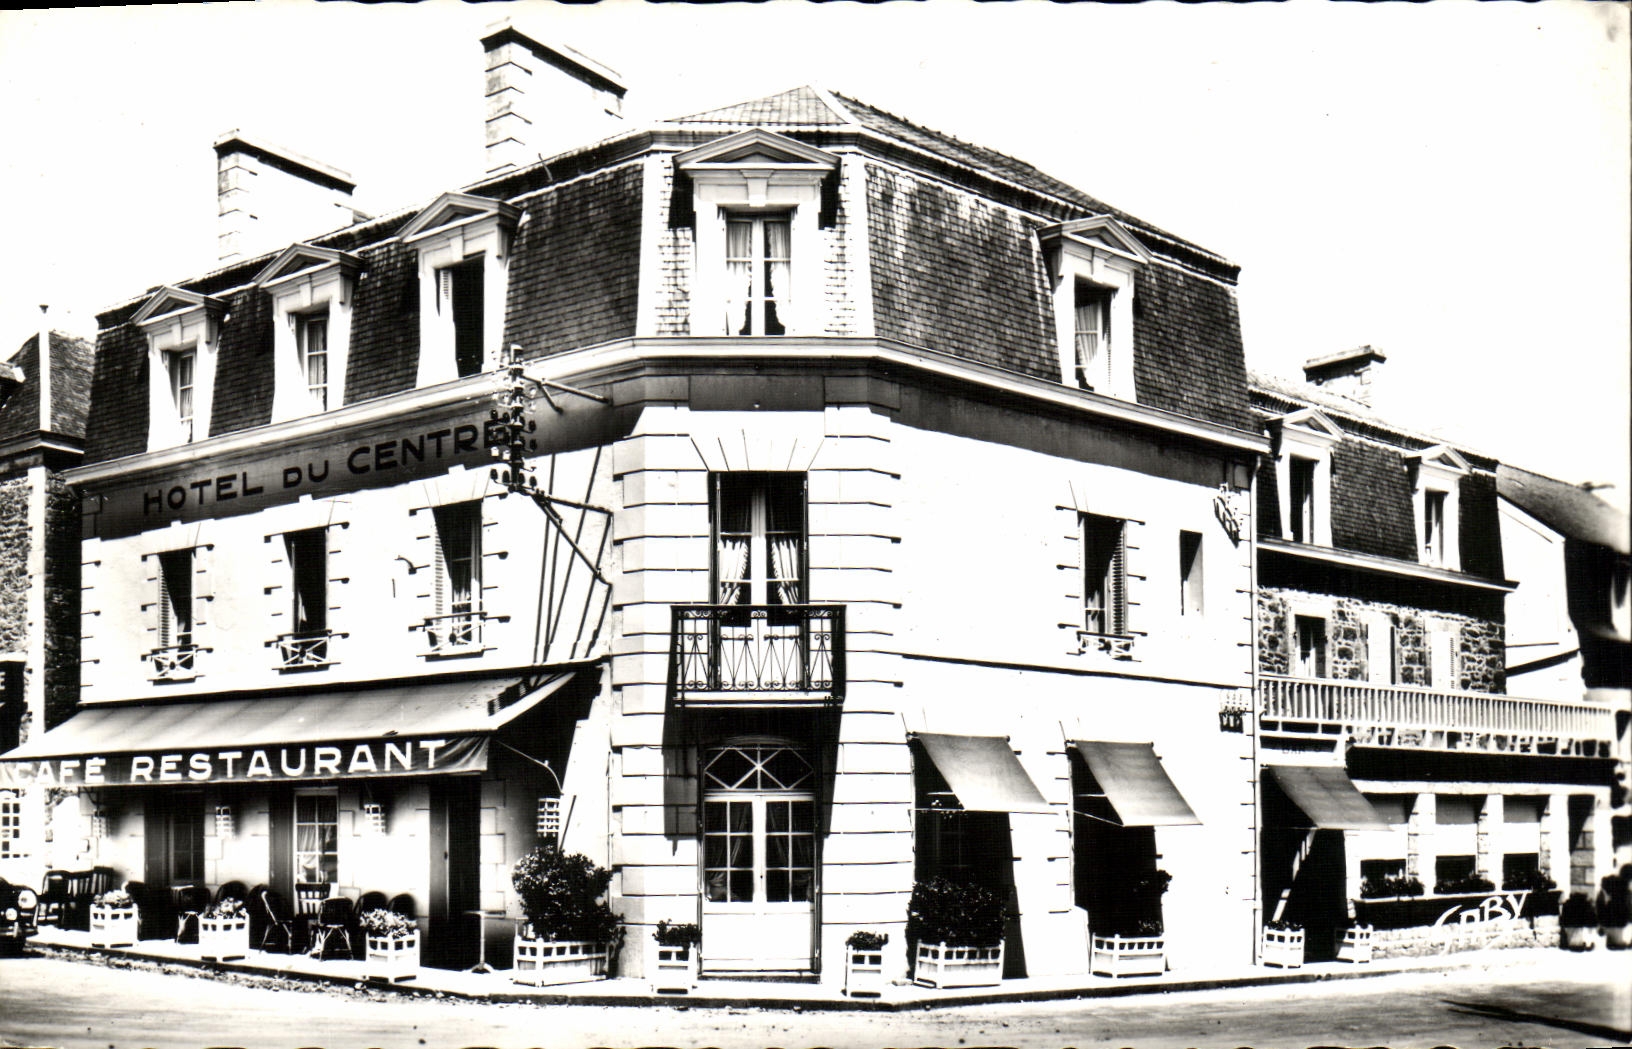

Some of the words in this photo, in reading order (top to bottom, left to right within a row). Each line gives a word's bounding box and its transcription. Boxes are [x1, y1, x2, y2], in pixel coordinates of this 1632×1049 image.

[143, 472, 263, 516] HOTEL
[283, 460, 329, 489] DU
[347, 417, 509, 475] CENTRE
[15, 757, 106, 786] CAFÉ
[130, 739, 447, 783] RESTAURANT
